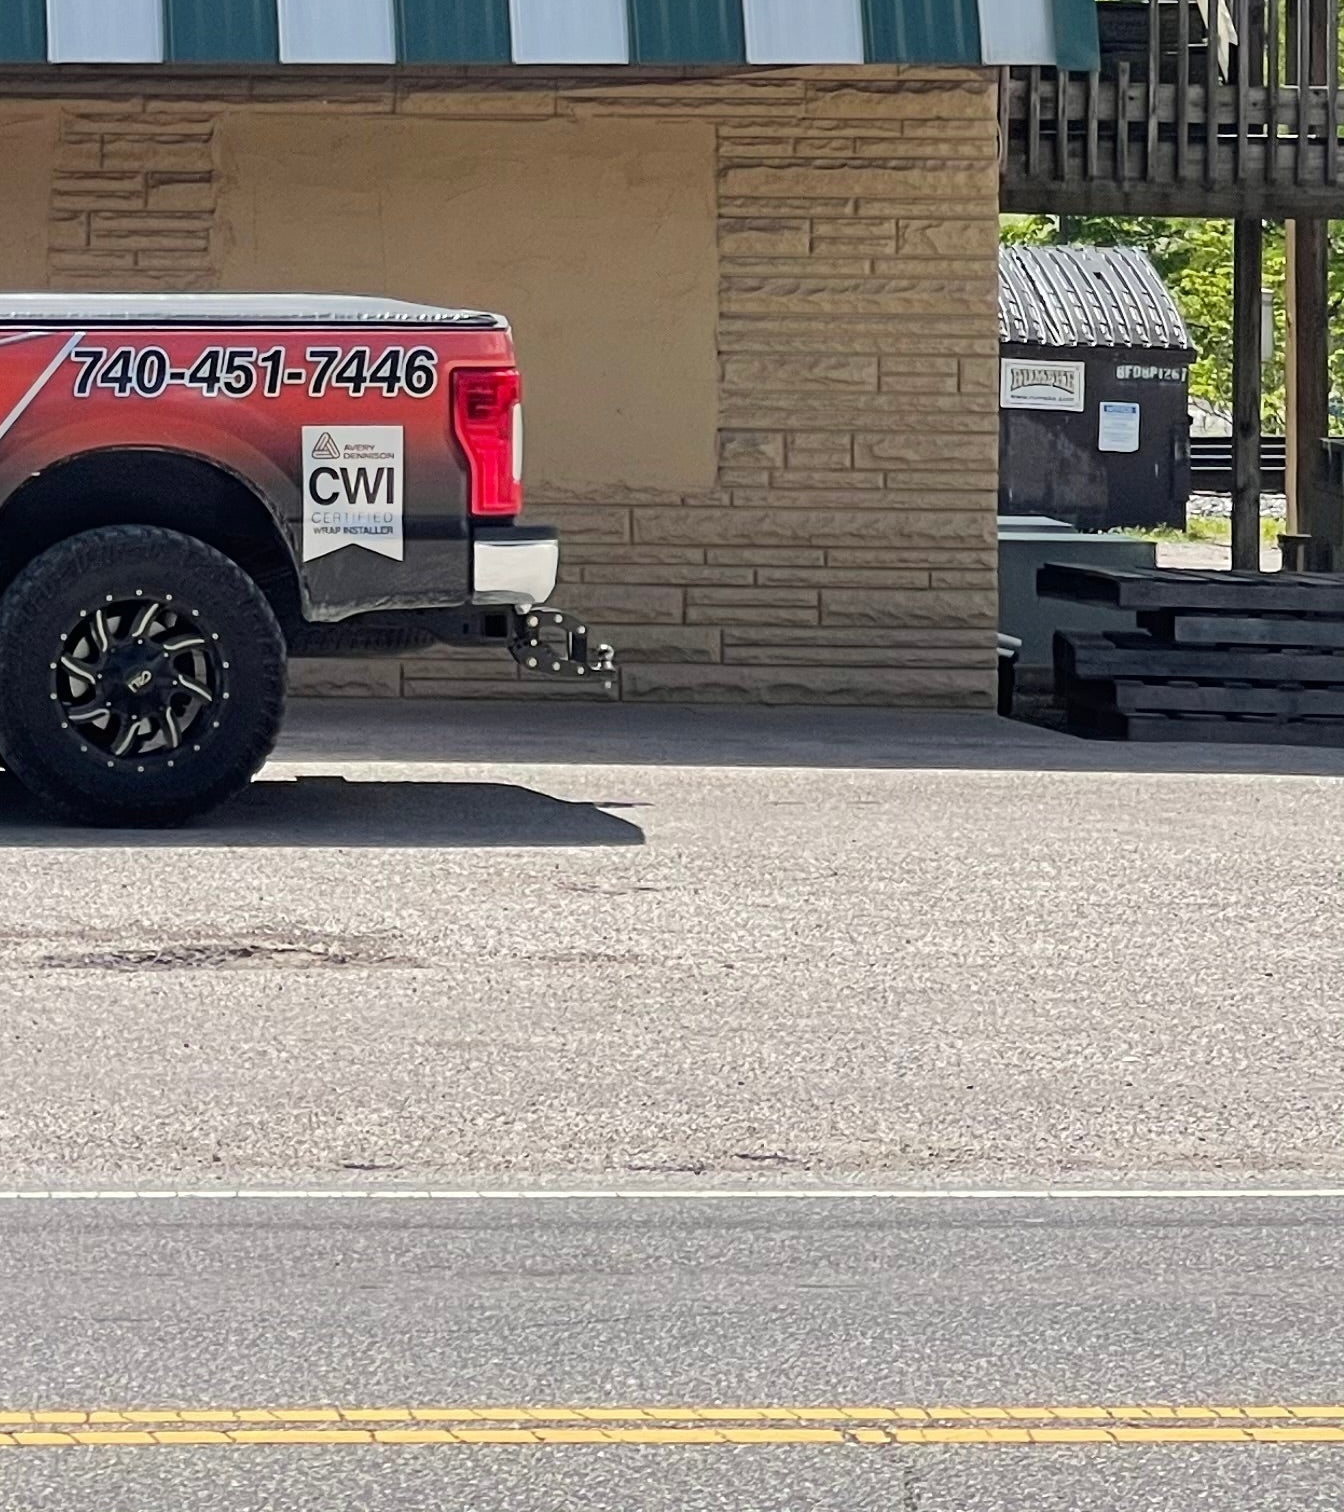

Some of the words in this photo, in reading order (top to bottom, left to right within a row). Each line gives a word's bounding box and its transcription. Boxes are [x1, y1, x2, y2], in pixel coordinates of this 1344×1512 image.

[71, 346, 437, 398] 740-451-7446
[309, 466, 394, 505] CWI
[312, 512, 393, 524] CERTIFIED
[313, 526, 340, 535] WRAP
[343, 526, 394, 535] INSTALLER
